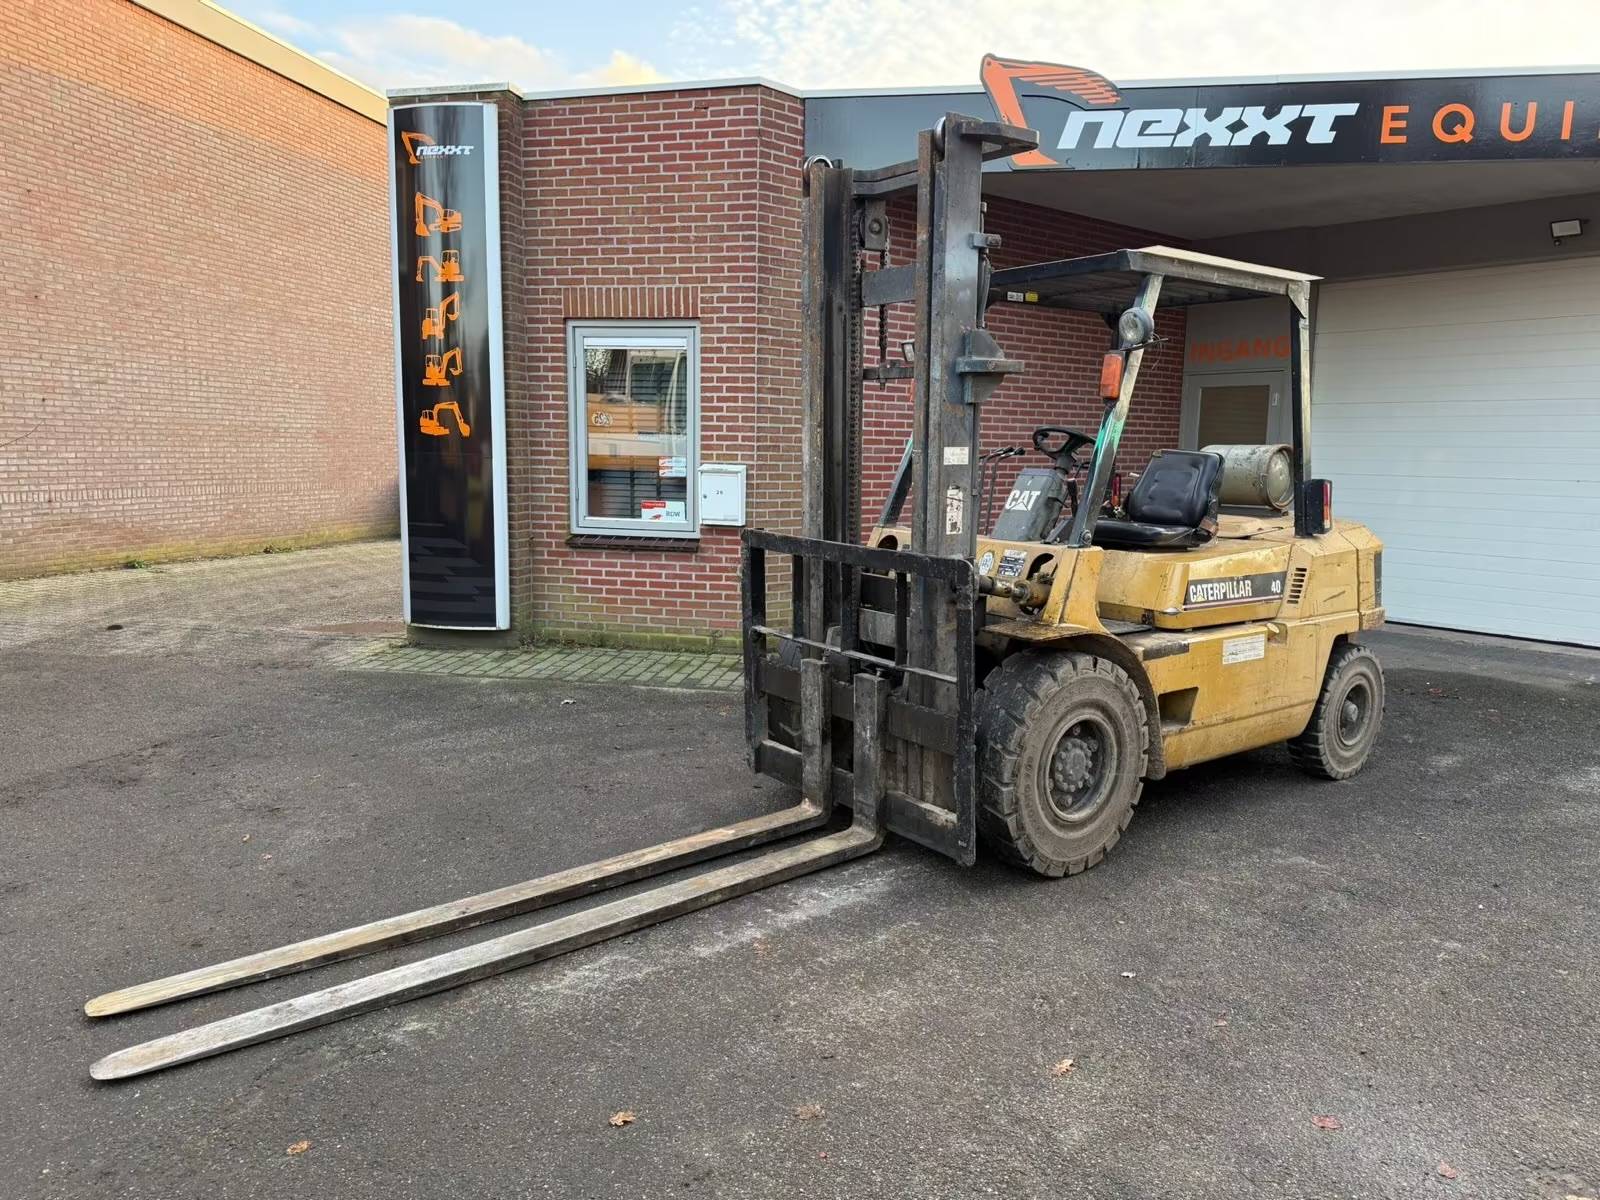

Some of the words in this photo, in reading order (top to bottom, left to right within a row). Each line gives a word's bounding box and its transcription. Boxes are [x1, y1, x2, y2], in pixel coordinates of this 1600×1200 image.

[1380, 100, 1600, 145] EQUI
[1189, 335, 1290, 365] INGANG
[1005, 490, 1041, 511] CAT
[1189, 579, 1252, 603] CATERPILLAR
[1270, 579, 1281, 594] 40
